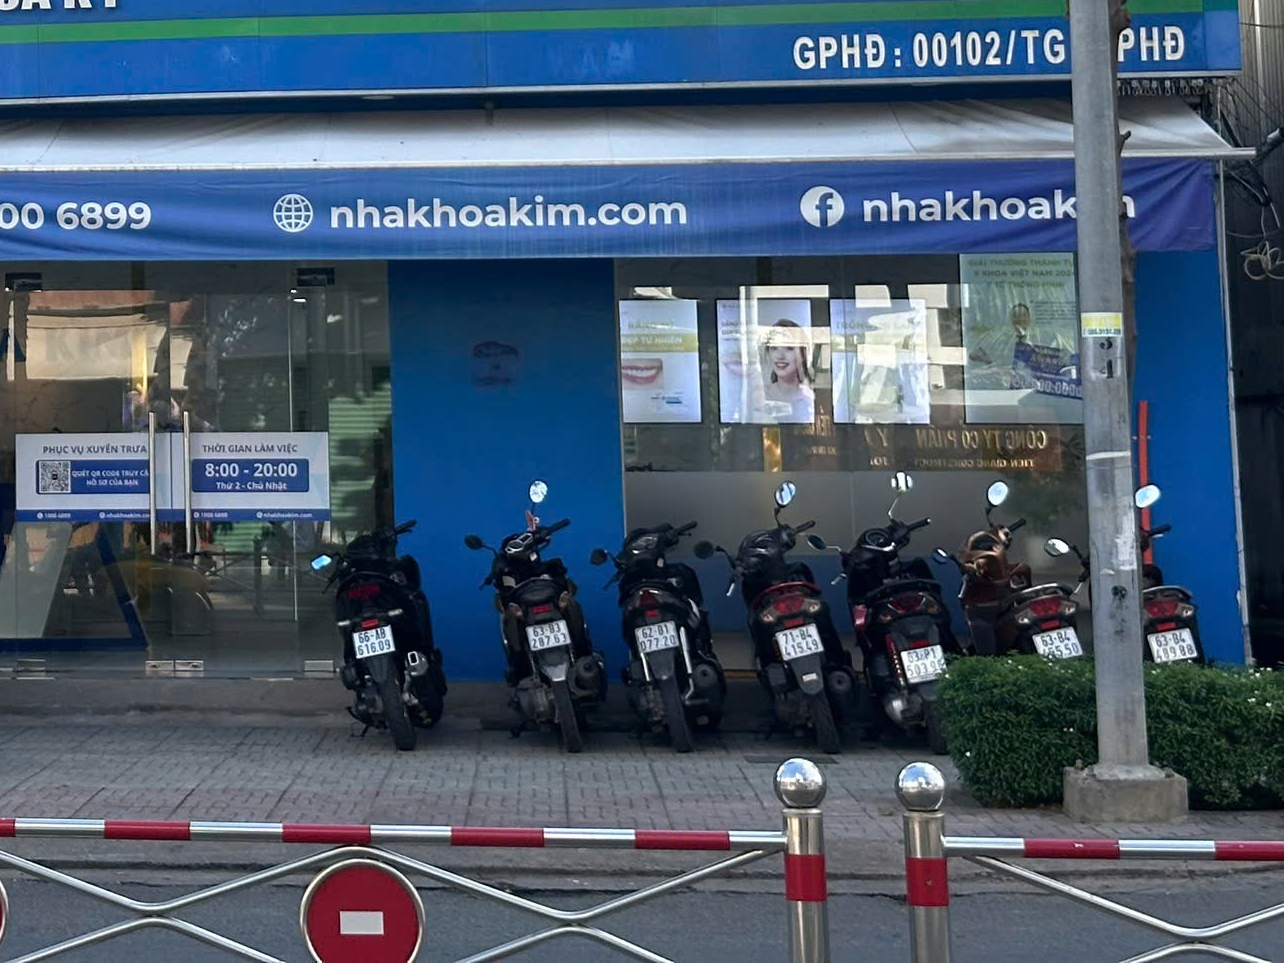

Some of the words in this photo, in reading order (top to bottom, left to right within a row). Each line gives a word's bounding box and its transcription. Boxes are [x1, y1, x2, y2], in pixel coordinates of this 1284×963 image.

[793, 33, 886, 70] GPHĐ
[330, 194, 687, 230] nhakhoakim.com
[863, 188, 1135, 224] nhakhoak
[56, 201, 152, 231] 6899
[43, 445, 68, 456] PHỤC
[71, 445, 84, 455] VỤ
[86, 443, 118, 453] XUYÊN
[121, 445, 147, 453] TRƯA
[202, 443, 226, 453] THỜI
[228, 445, 252, 453] GIAN
[254, 443, 274, 453] LÀM
[276, 443, 298, 454] VIỆC
[205, 463, 239, 477] 8:00
[253, 463, 298, 477] 20:00
[216, 481, 233, 490] Thứ
[235, 482, 240, 490] 2
[247, 481, 264, 490] Chủ
[266, 481, 287, 491] Nhật
[357, 640, 392, 657] 616.09
